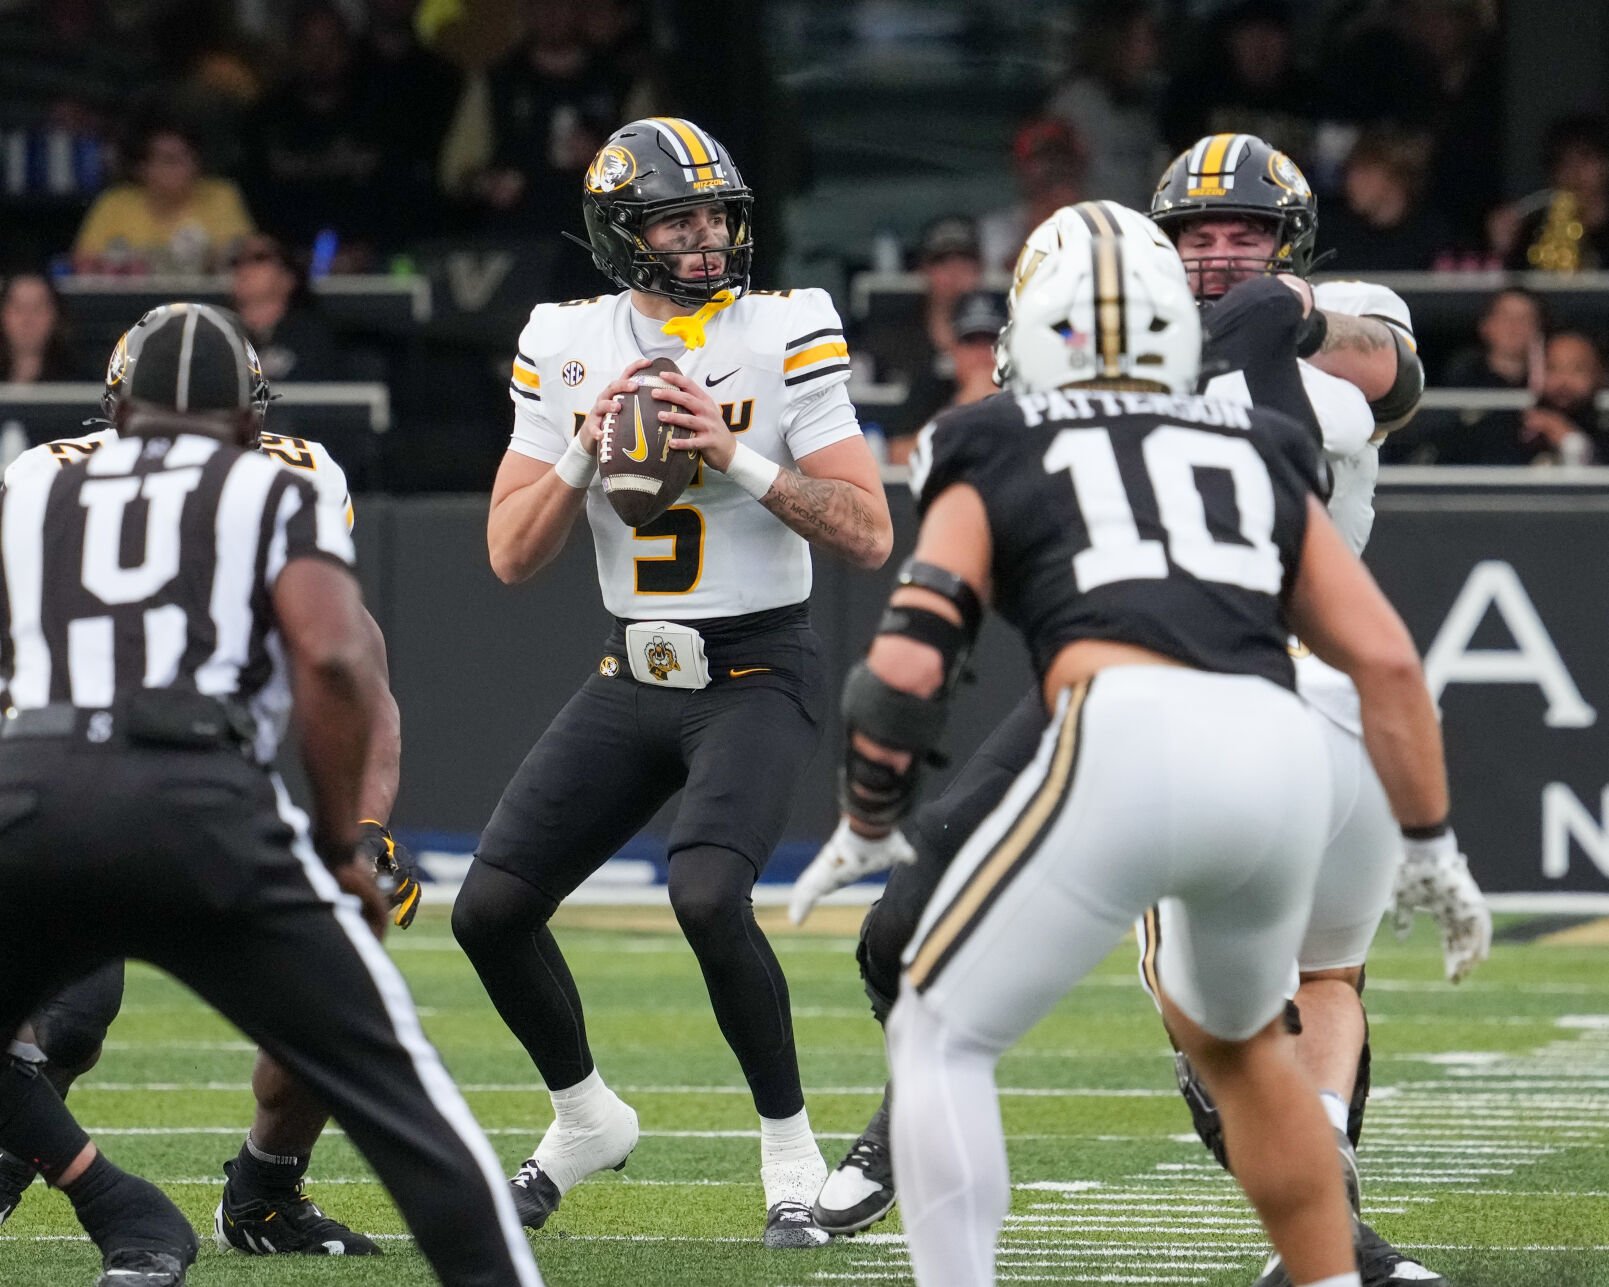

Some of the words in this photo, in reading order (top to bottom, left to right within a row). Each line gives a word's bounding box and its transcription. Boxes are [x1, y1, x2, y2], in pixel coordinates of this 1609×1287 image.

[563, 361, 585, 387] SEC
[1015, 389, 1252, 430] PATTERSON
[78, 463, 205, 605] U
[1042, 423, 1285, 596] 10
